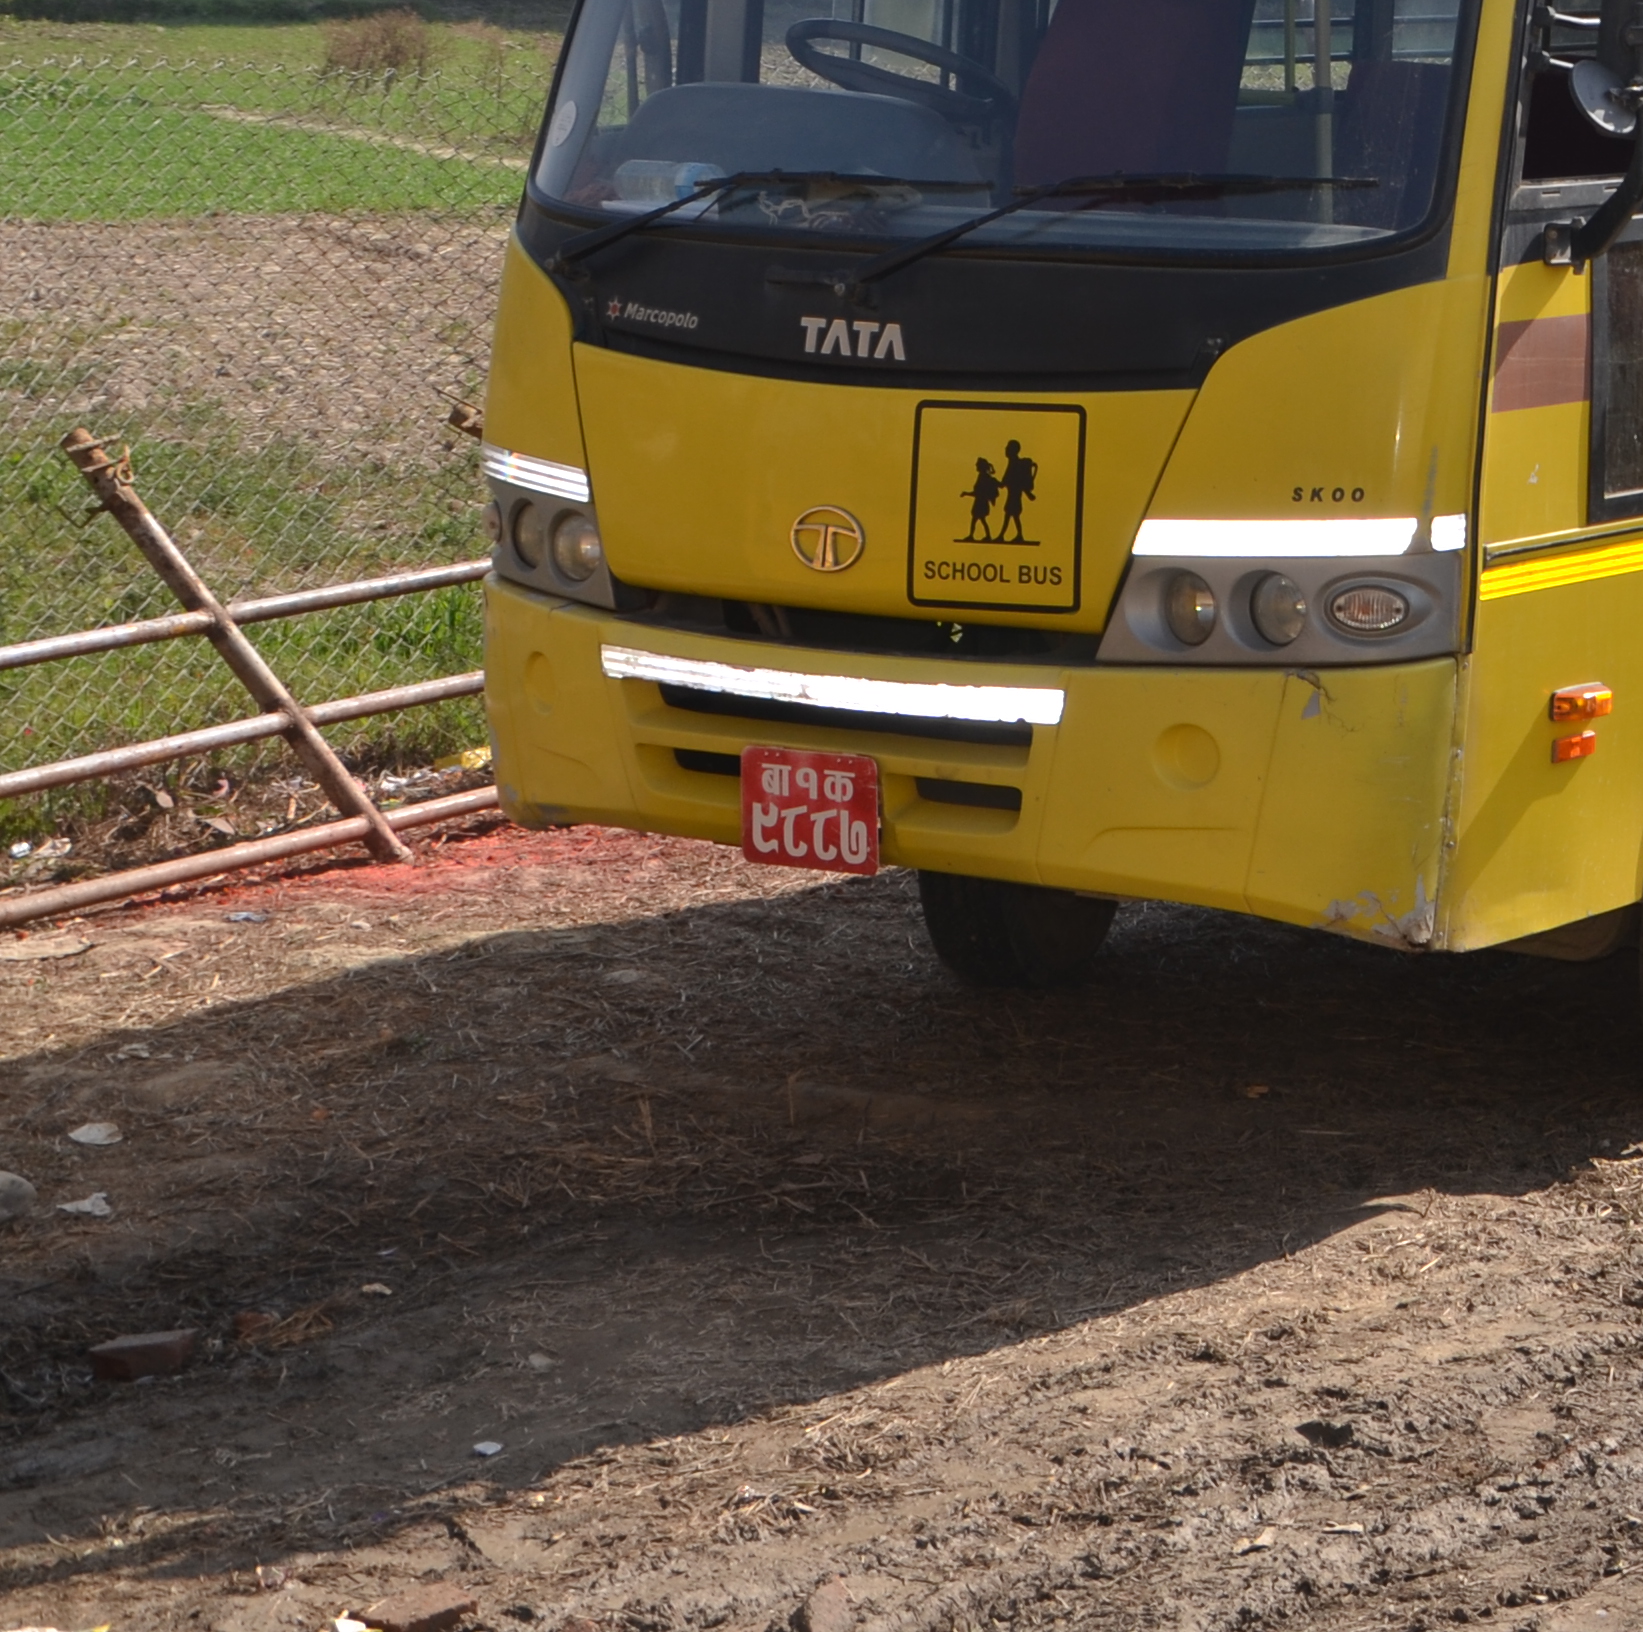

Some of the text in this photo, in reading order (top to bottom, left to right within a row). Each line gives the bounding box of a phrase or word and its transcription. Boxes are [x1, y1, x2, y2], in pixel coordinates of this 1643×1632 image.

[624, 303, 698, 329] Marcopolo
[801, 317, 905, 360] TATA
[1292, 487, 1365, 502] SKOO
[923, 560, 1062, 586] SCHOOL BUS
